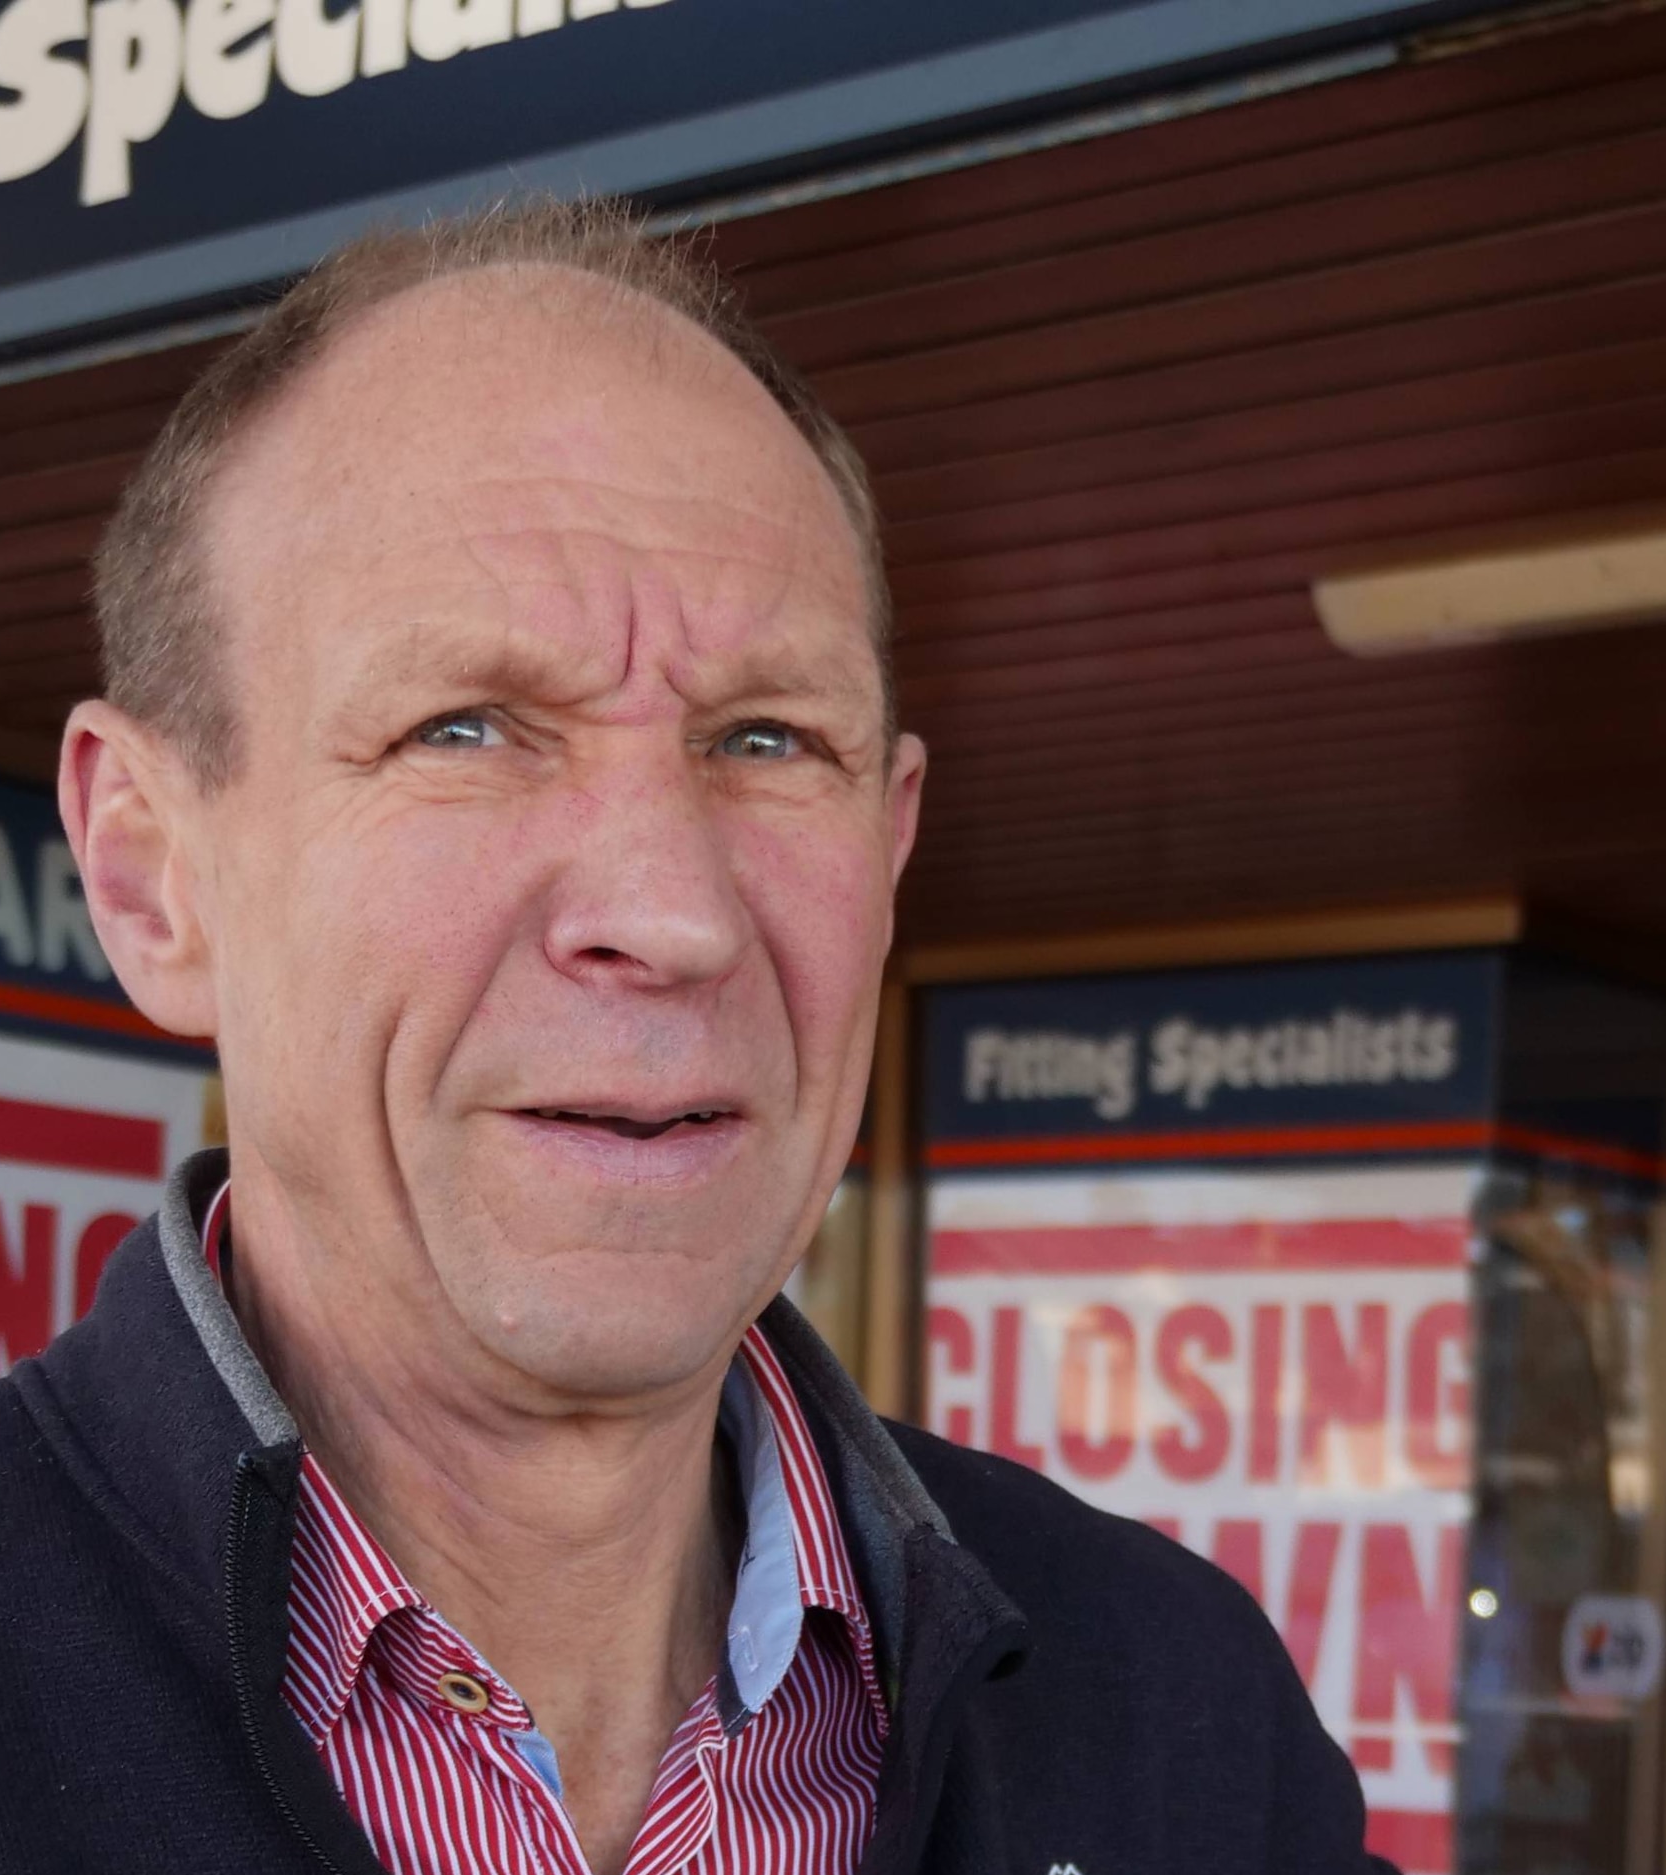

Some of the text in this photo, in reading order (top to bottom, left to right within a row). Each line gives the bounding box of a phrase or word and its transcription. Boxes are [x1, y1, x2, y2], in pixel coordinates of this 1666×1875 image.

[964, 1007, 1458, 1121] Fitting Specialists
[925, 1300, 1473, 1491] CLOSING
